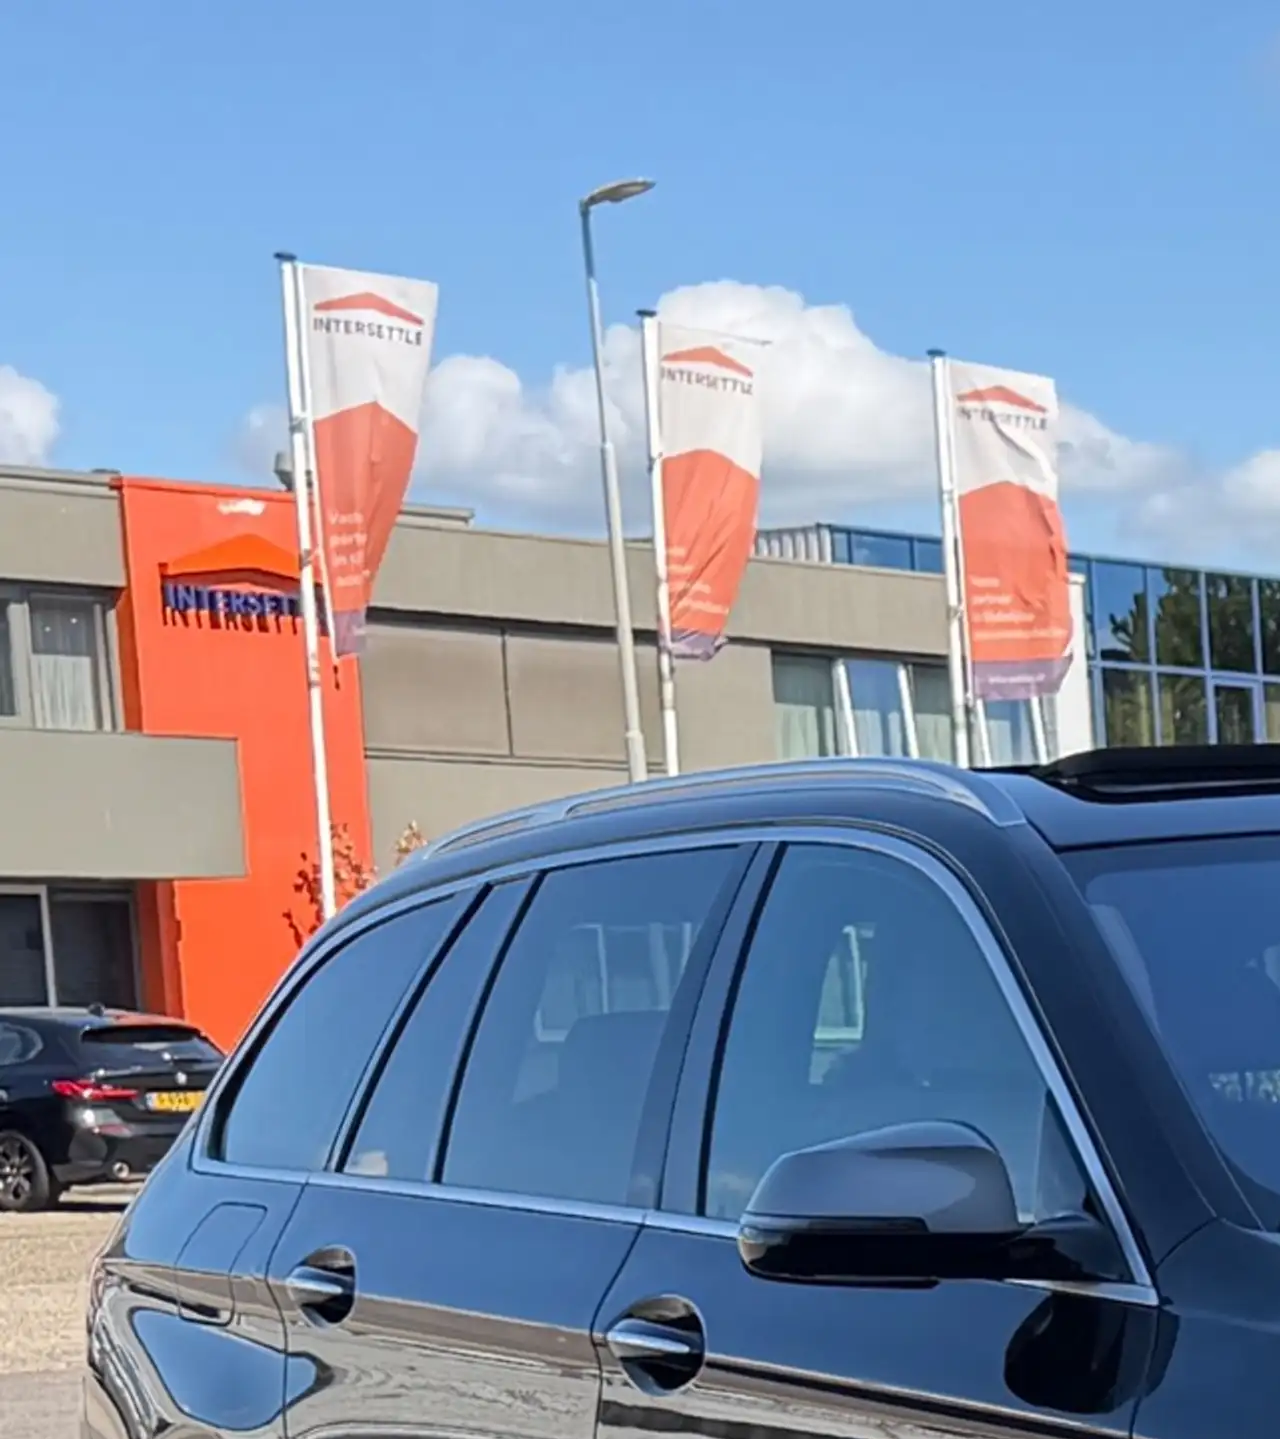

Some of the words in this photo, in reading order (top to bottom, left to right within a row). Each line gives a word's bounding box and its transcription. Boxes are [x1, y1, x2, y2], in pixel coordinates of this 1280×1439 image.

[313, 317, 423, 346] INTERSETTLE
[660, 366, 754, 396] INTERSETTLE
[957, 406, 1047, 431] INTEETTLE
